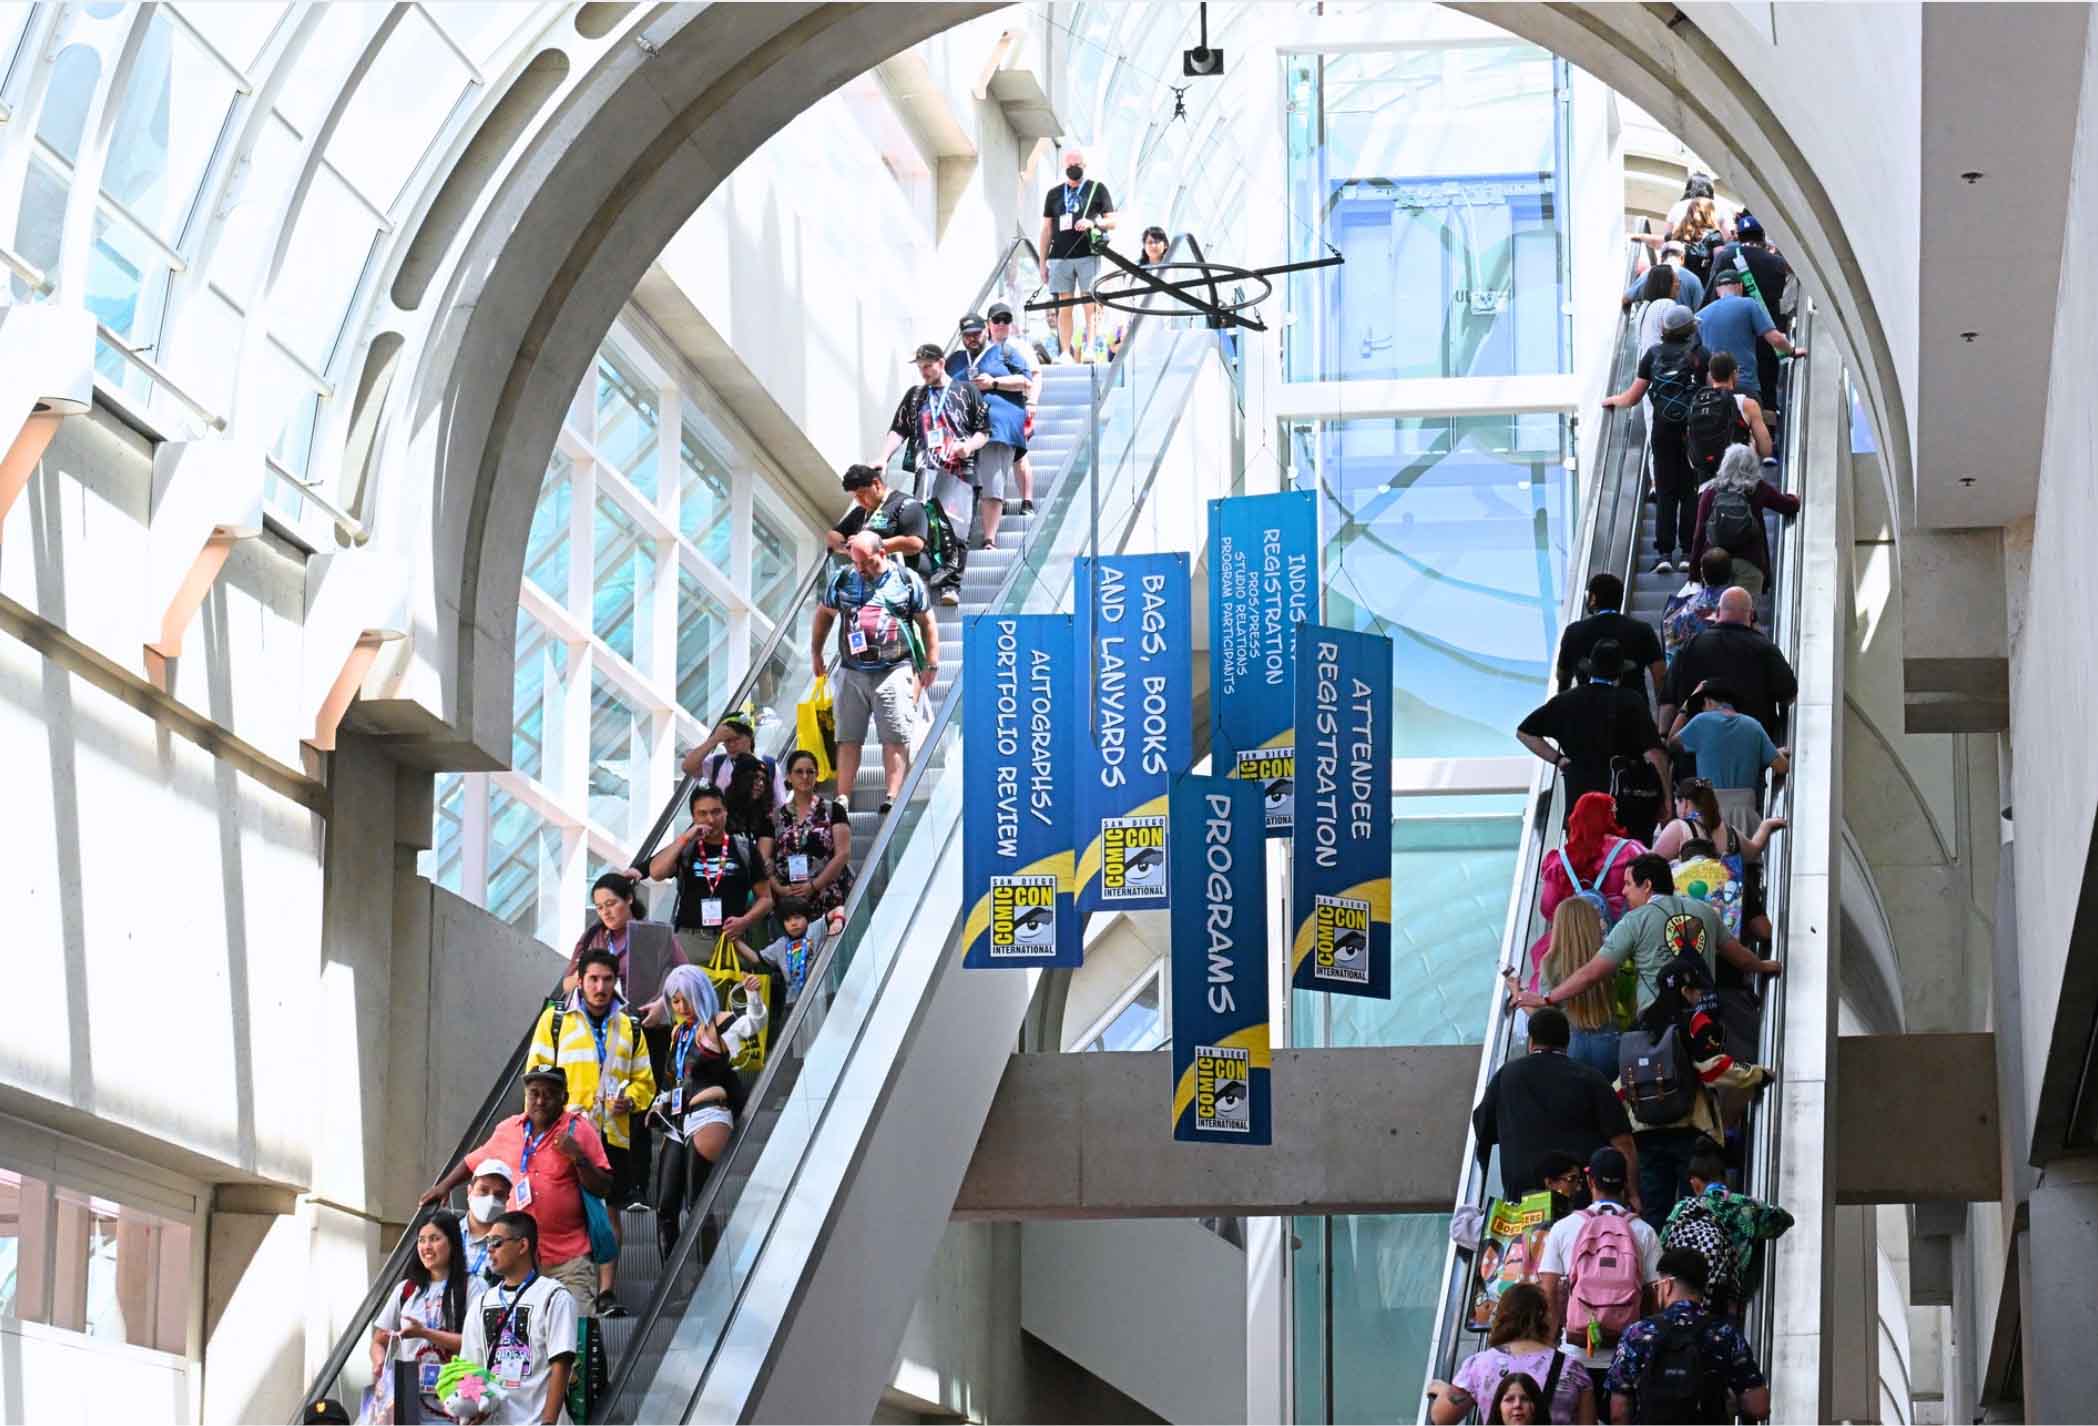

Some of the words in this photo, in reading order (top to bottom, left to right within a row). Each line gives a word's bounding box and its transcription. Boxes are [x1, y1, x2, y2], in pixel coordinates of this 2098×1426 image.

[1100, 566, 1126, 623] AND
[1221, 536, 1233, 599] PROGRAM
[1234, 551, 1247, 600] STUDIO
[1139, 575, 1167, 662] BAGS,
[1248, 571, 1261, 659] PROS/PRESS
[1264, 528, 1283, 685] REGISTRATION
[1222, 603, 1235, 695] PARTICIPANTS
[1235, 604, 1248, 676] RELATIONS
[997, 620, 1018, 756] PORTFOLIO
[1100, 637, 1126, 788] LANYARDS
[1031, 649, 1053, 825] AUTOGRAPHS/
[1142, 676, 1168, 775] BOOKS
[1315, 641, 1339, 867] REGISTRATION
[1260, 758, 1294, 779] CON
[1351, 677, 1373, 841] ATTENDEE
[997, 766, 1018, 857] REVIEW
[1103, 820, 1123, 828] SAN
[1132, 818, 1164, 827] DIEGO
[1125, 827, 1163, 848] CON
[993, 878, 1013, 886] SAN
[1105, 828, 1125, 887] COMIC
[994, 887, 1014, 945] COMIC
[1015, 886, 1053, 907] CON
[1104, 886, 1164, 897] INTERNATIONAL
[1205, 794, 1236, 1014] PROGRAMS
[1335, 908, 1367, 930] CON
[993, 944, 1054, 954] INTERNATIONAL
[1317, 906, 1334, 966] COMIC
[1317, 966, 1367, 980] INTERNATIONAL
[1197, 1047, 1213, 1056] SAN
[1220, 1050, 1247, 1058] DIEGO
[1215, 1059, 1246, 1081] CON
[1198, 1057, 1214, 1117] COMIC
[1198, 1119, 1248, 1130] INTERNATIONAL
